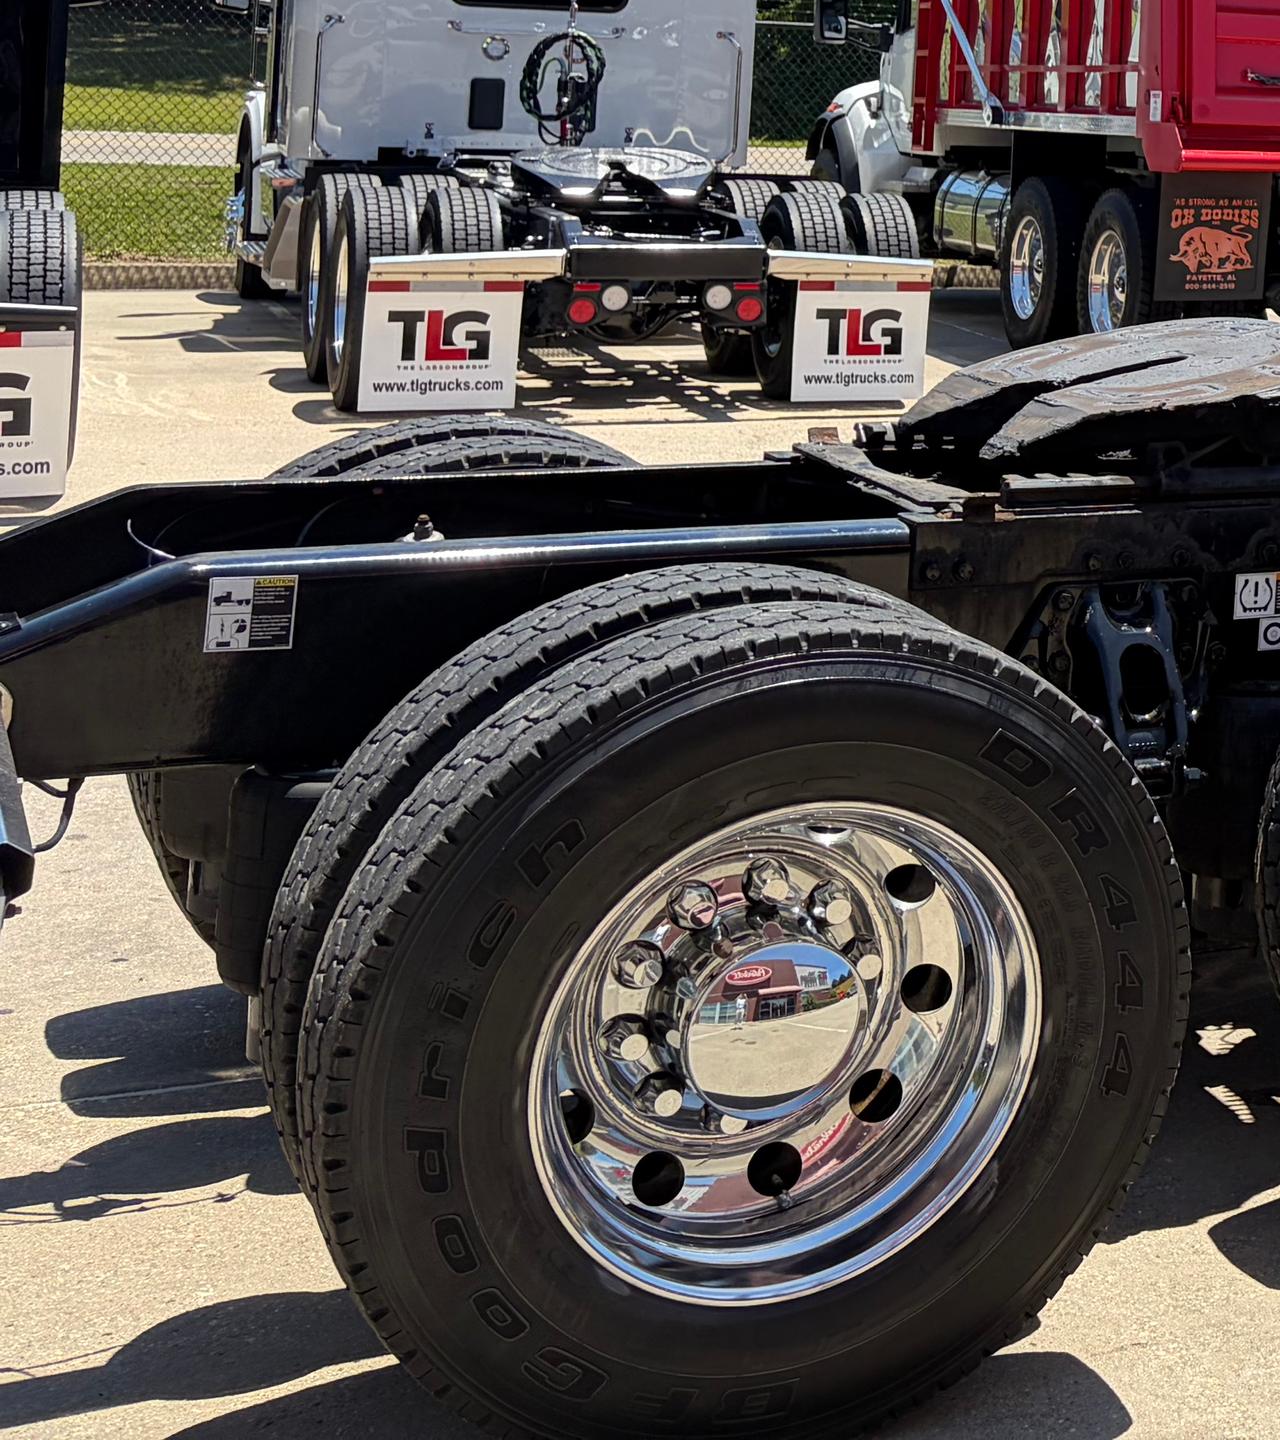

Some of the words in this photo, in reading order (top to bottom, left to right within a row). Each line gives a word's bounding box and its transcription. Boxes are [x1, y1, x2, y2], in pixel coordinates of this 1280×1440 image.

[1188, 198, 1216, 206] STRONG
[1219, 198, 1229, 206] AS
[1170, 208, 1195, 229] OX
[1200, 208, 1260, 229] BODIES
[1186, 274, 1224, 282] FAYETTE,
[388, 310, 491, 361] TLG
[816, 308, 903, 356] TLG
[372, 378, 503, 395] www.tlgtrucks.com
[803, 371, 914, 387] www.tlgtrucks.com
[403, 817, 804, 1426] BFGoodrich
